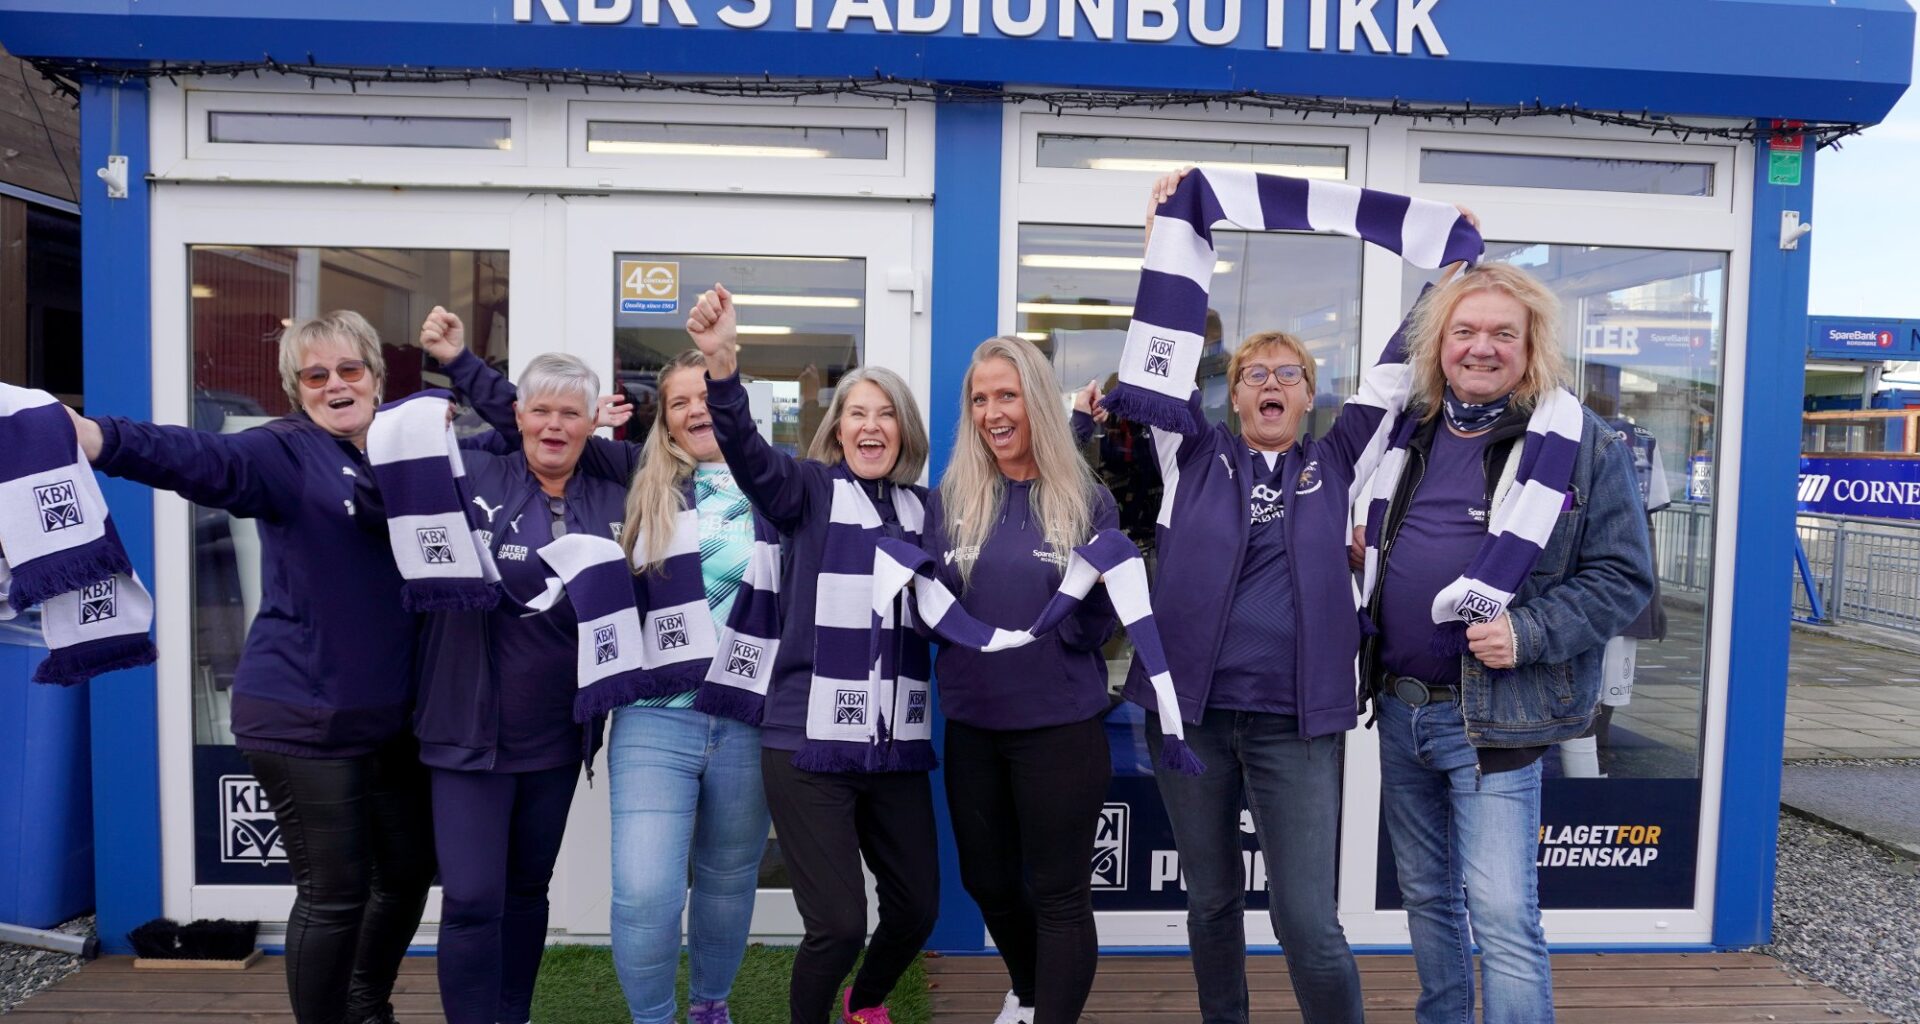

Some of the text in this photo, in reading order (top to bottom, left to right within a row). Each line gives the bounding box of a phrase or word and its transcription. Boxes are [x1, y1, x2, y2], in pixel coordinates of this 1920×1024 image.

[625, 267, 673, 295] 40
[1829, 329, 1878, 341] SpareBank
[1151, 340, 1173, 357] KBK
[38, 484, 74, 507] KBK
[420, 530, 448, 545] KBK
[83, 579, 114, 601] KBK
[1465, 594, 1498, 616] KBK
[658, 615, 684, 633] KBK
[595, 627, 614, 645] KBK
[733, 642, 760, 661] KBK
[839, 692, 865, 706] KBK
[230, 785, 271, 813] KB
